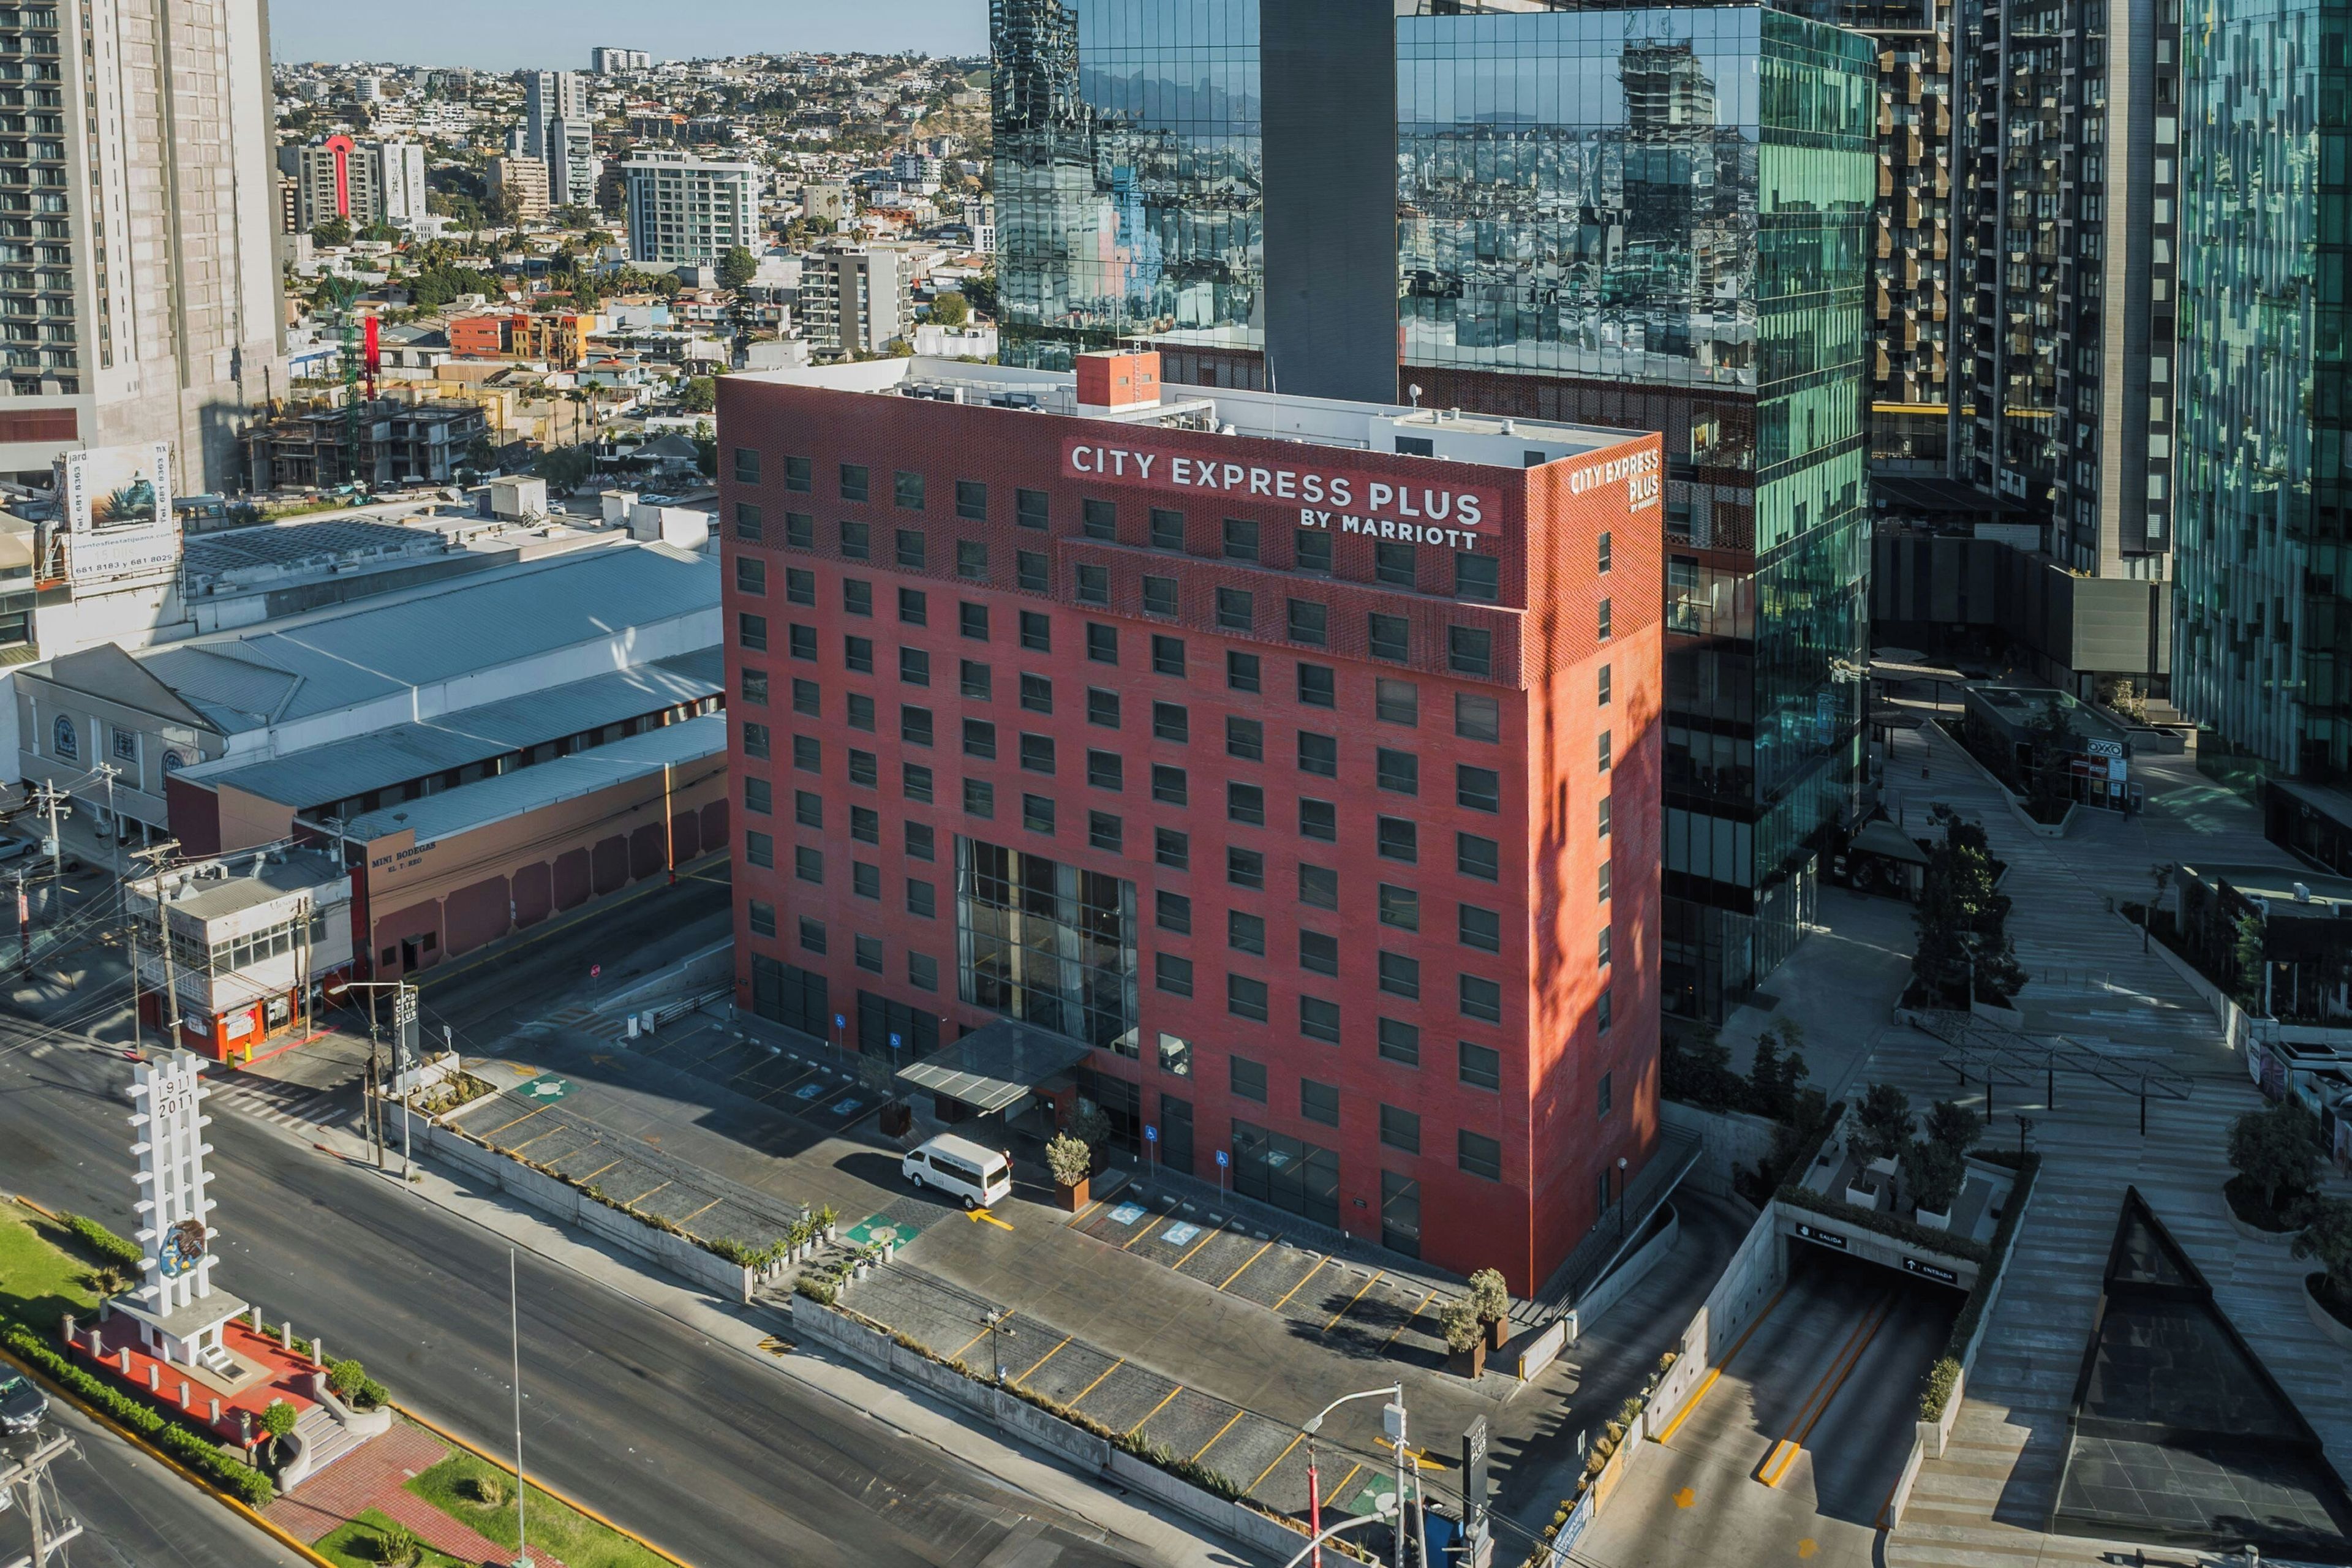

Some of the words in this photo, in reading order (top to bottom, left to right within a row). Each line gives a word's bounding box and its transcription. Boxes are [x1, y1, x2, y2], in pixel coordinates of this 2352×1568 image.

[1571, 466, 1602, 495] CITY
[1605, 449, 1659, 483] EXPRESS
[1072, 446, 1155, 479] CITY
[1172, 458, 1352, 507] EXPRESS
[1370, 483, 1482, 525] PLUS
[1629, 475, 1659, 502] PLUS
[1301, 509, 1330, 528] BY
[1343, 515, 1477, 549] MARRIOTT
[97, 562, 119, 571] 8183
[151, 554, 173, 563] 8029
[2089, 742, 2120, 755] OXXO
[372, 855, 392, 868] MINI
[396, 842, 436, 861] BODEGAS
[158, 1075, 189, 1098] 1911
[159, 1093, 192, 1118] 2011
[1819, 1233, 1842, 1245] SALIDA
[1923, 1267, 1953, 1280] ENTRADA
